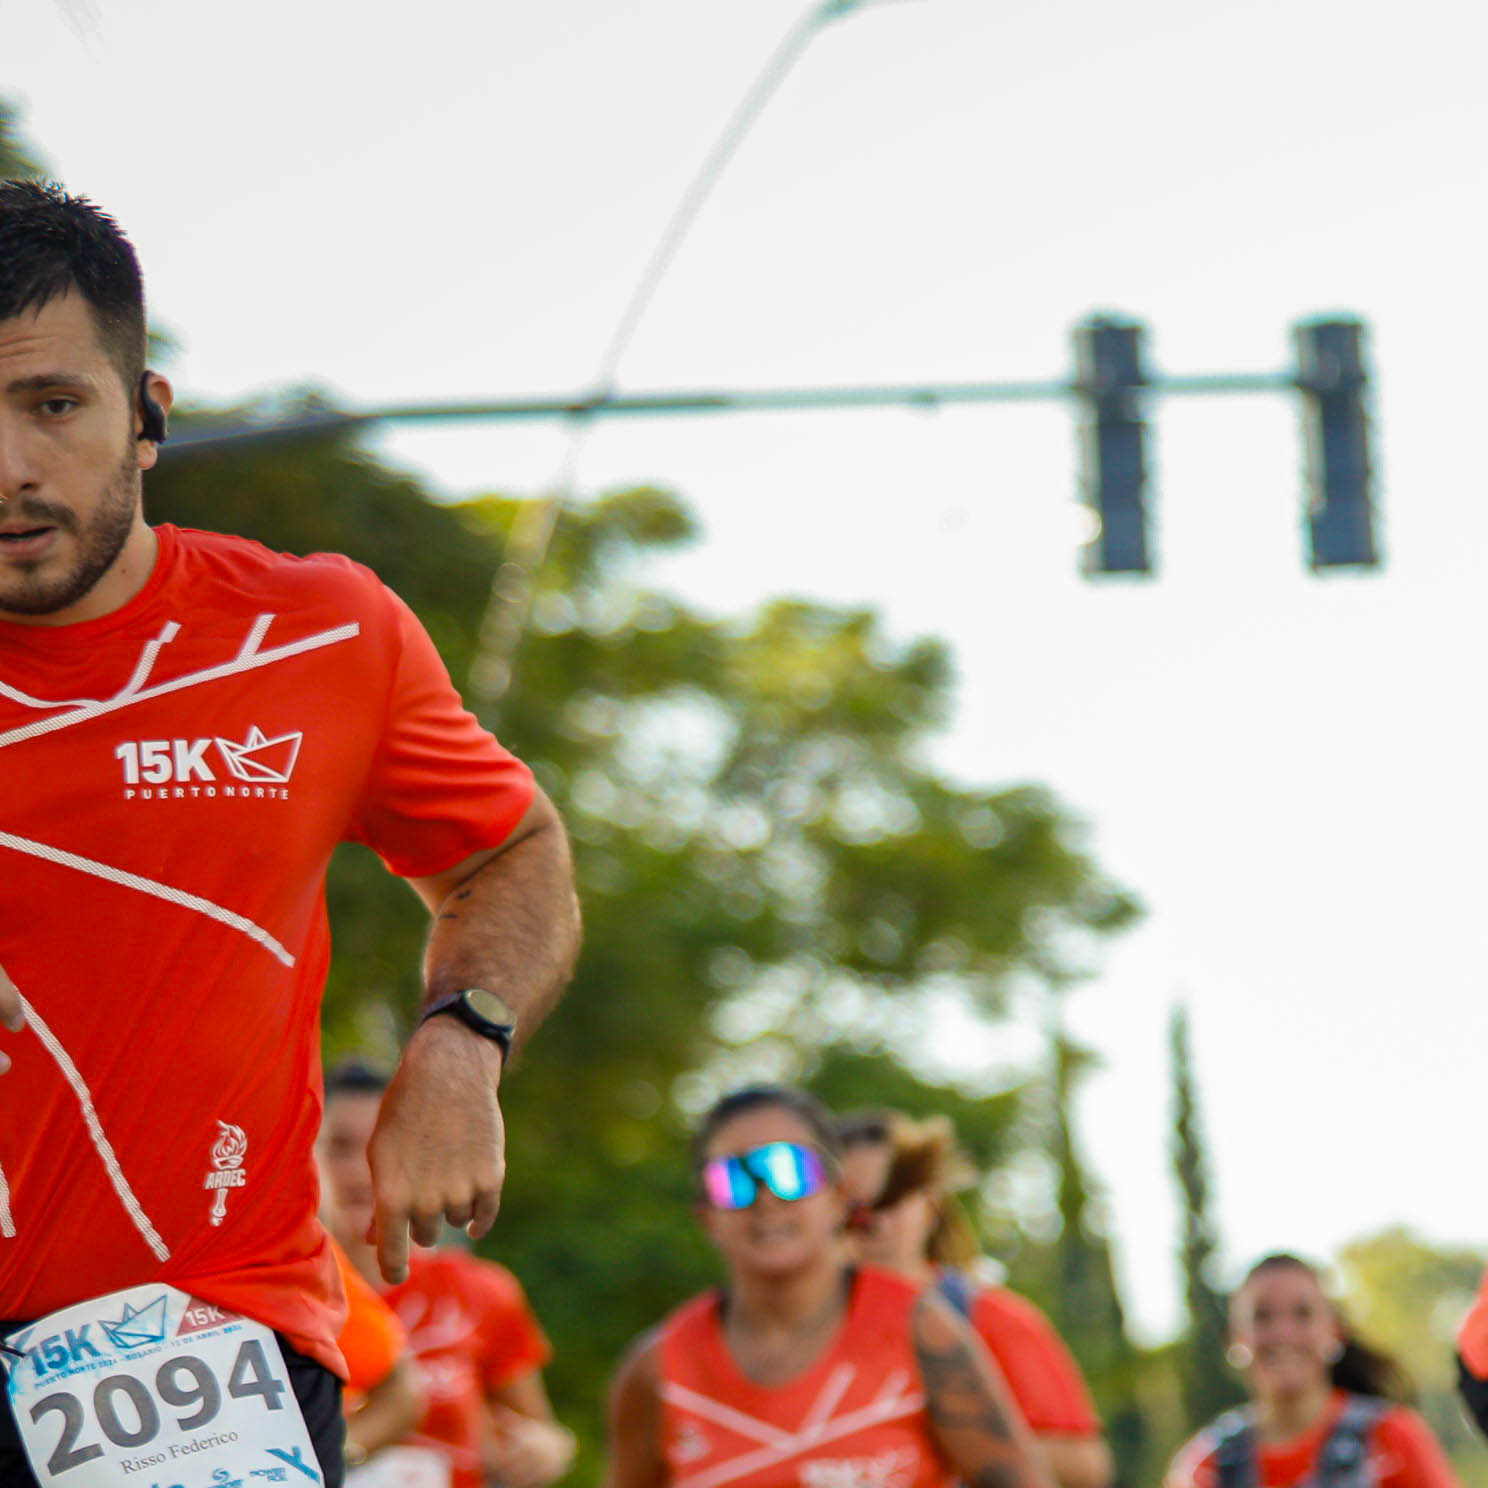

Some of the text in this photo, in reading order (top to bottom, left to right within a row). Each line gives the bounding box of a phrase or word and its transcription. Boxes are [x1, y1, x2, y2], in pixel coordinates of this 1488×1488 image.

[115, 739, 217, 784] 15K
[125, 786, 289, 800] PUERTO NORTE
[204, 1168, 247, 1190] ARDEC
[185, 1304, 225, 1327] 15K
[27, 1322, 101, 1377] 15K
[29, 1339, 284, 1476] 2094
[120, 1429, 239, 1475] Risso Federico
